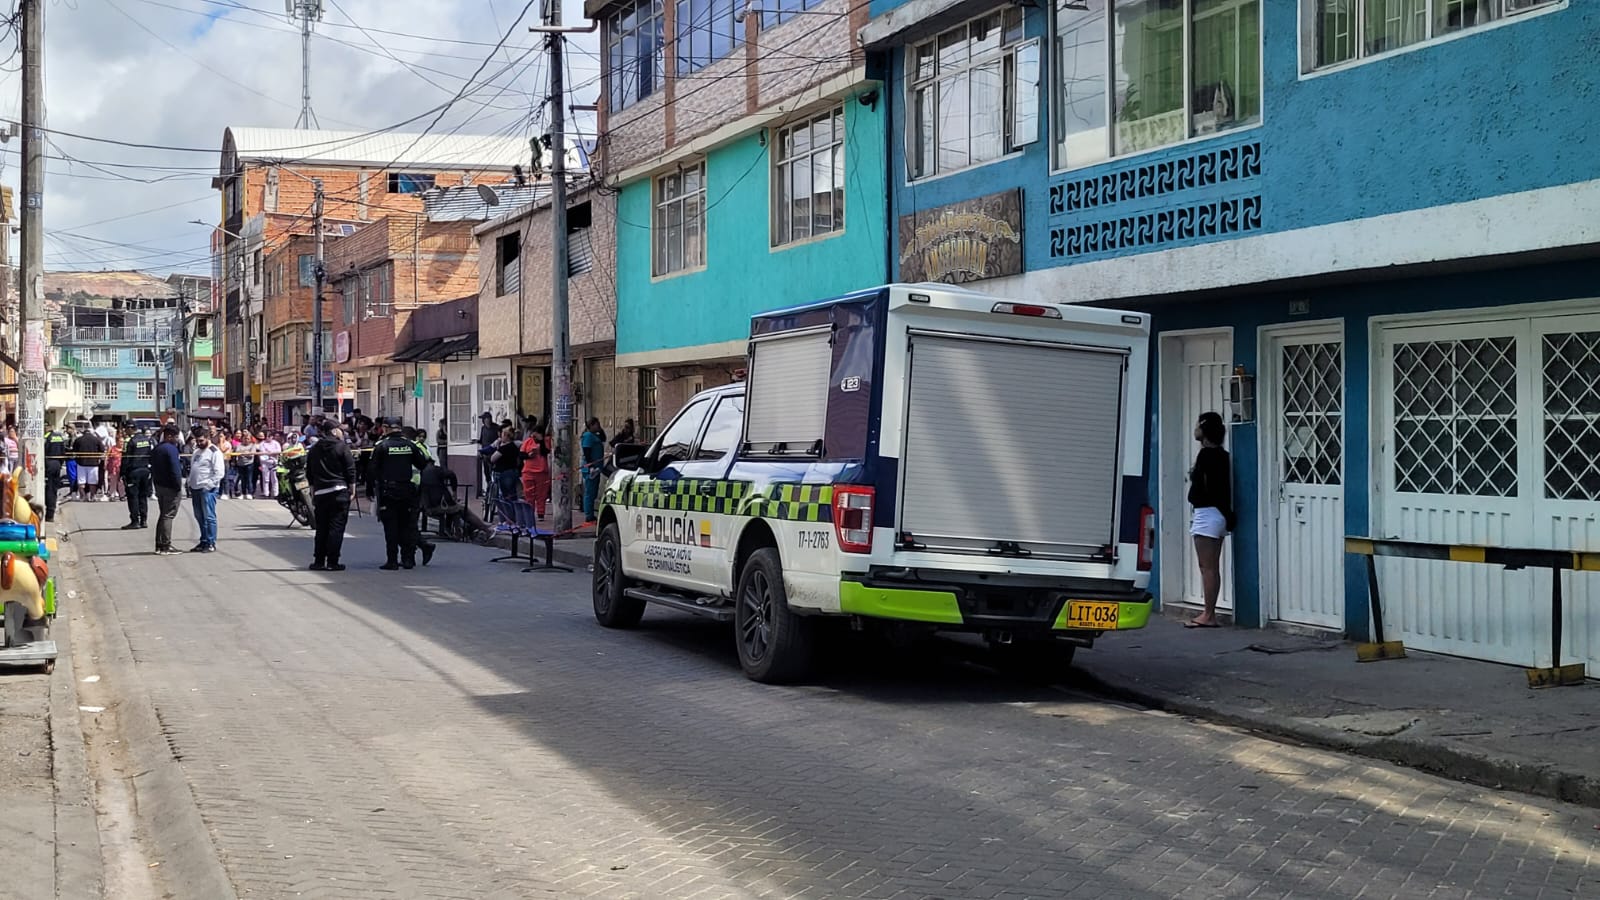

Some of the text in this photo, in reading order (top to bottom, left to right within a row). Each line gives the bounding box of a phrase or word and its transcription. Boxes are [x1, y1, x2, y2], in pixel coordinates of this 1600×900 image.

[647, 512, 697, 546] POLICÍA
[798, 531, 829, 549] 17-1-2763
[644, 544, 677, 559] LABORATORIO
[646, 558, 653, 569] DE
